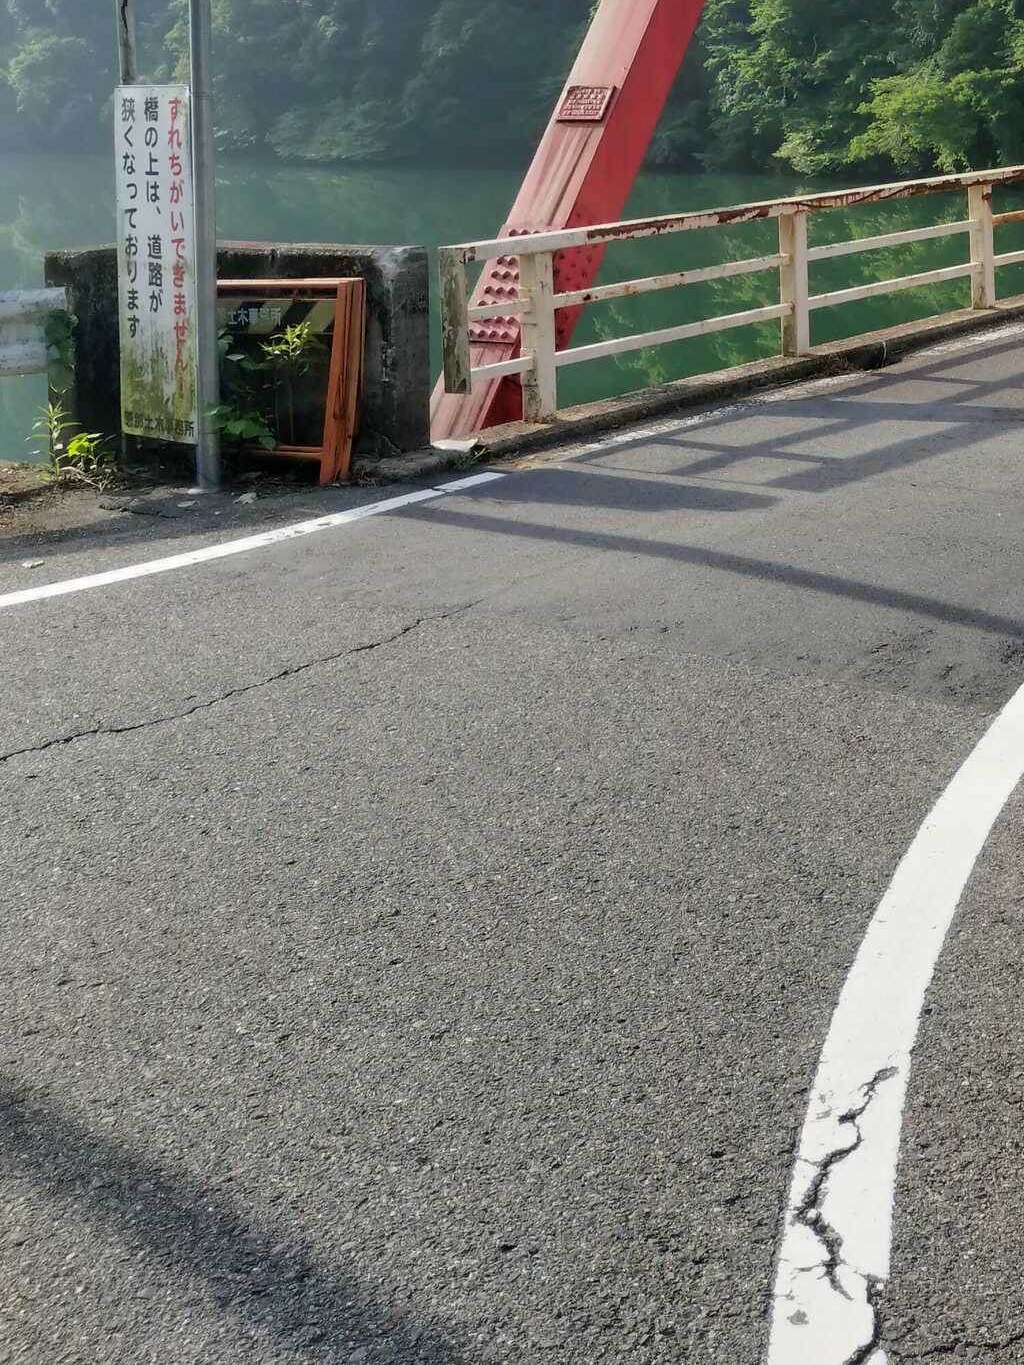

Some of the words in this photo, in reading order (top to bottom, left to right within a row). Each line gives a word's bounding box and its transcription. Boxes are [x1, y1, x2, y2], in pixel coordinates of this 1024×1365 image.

[121, 98, 140, 338] 狭くなっております
